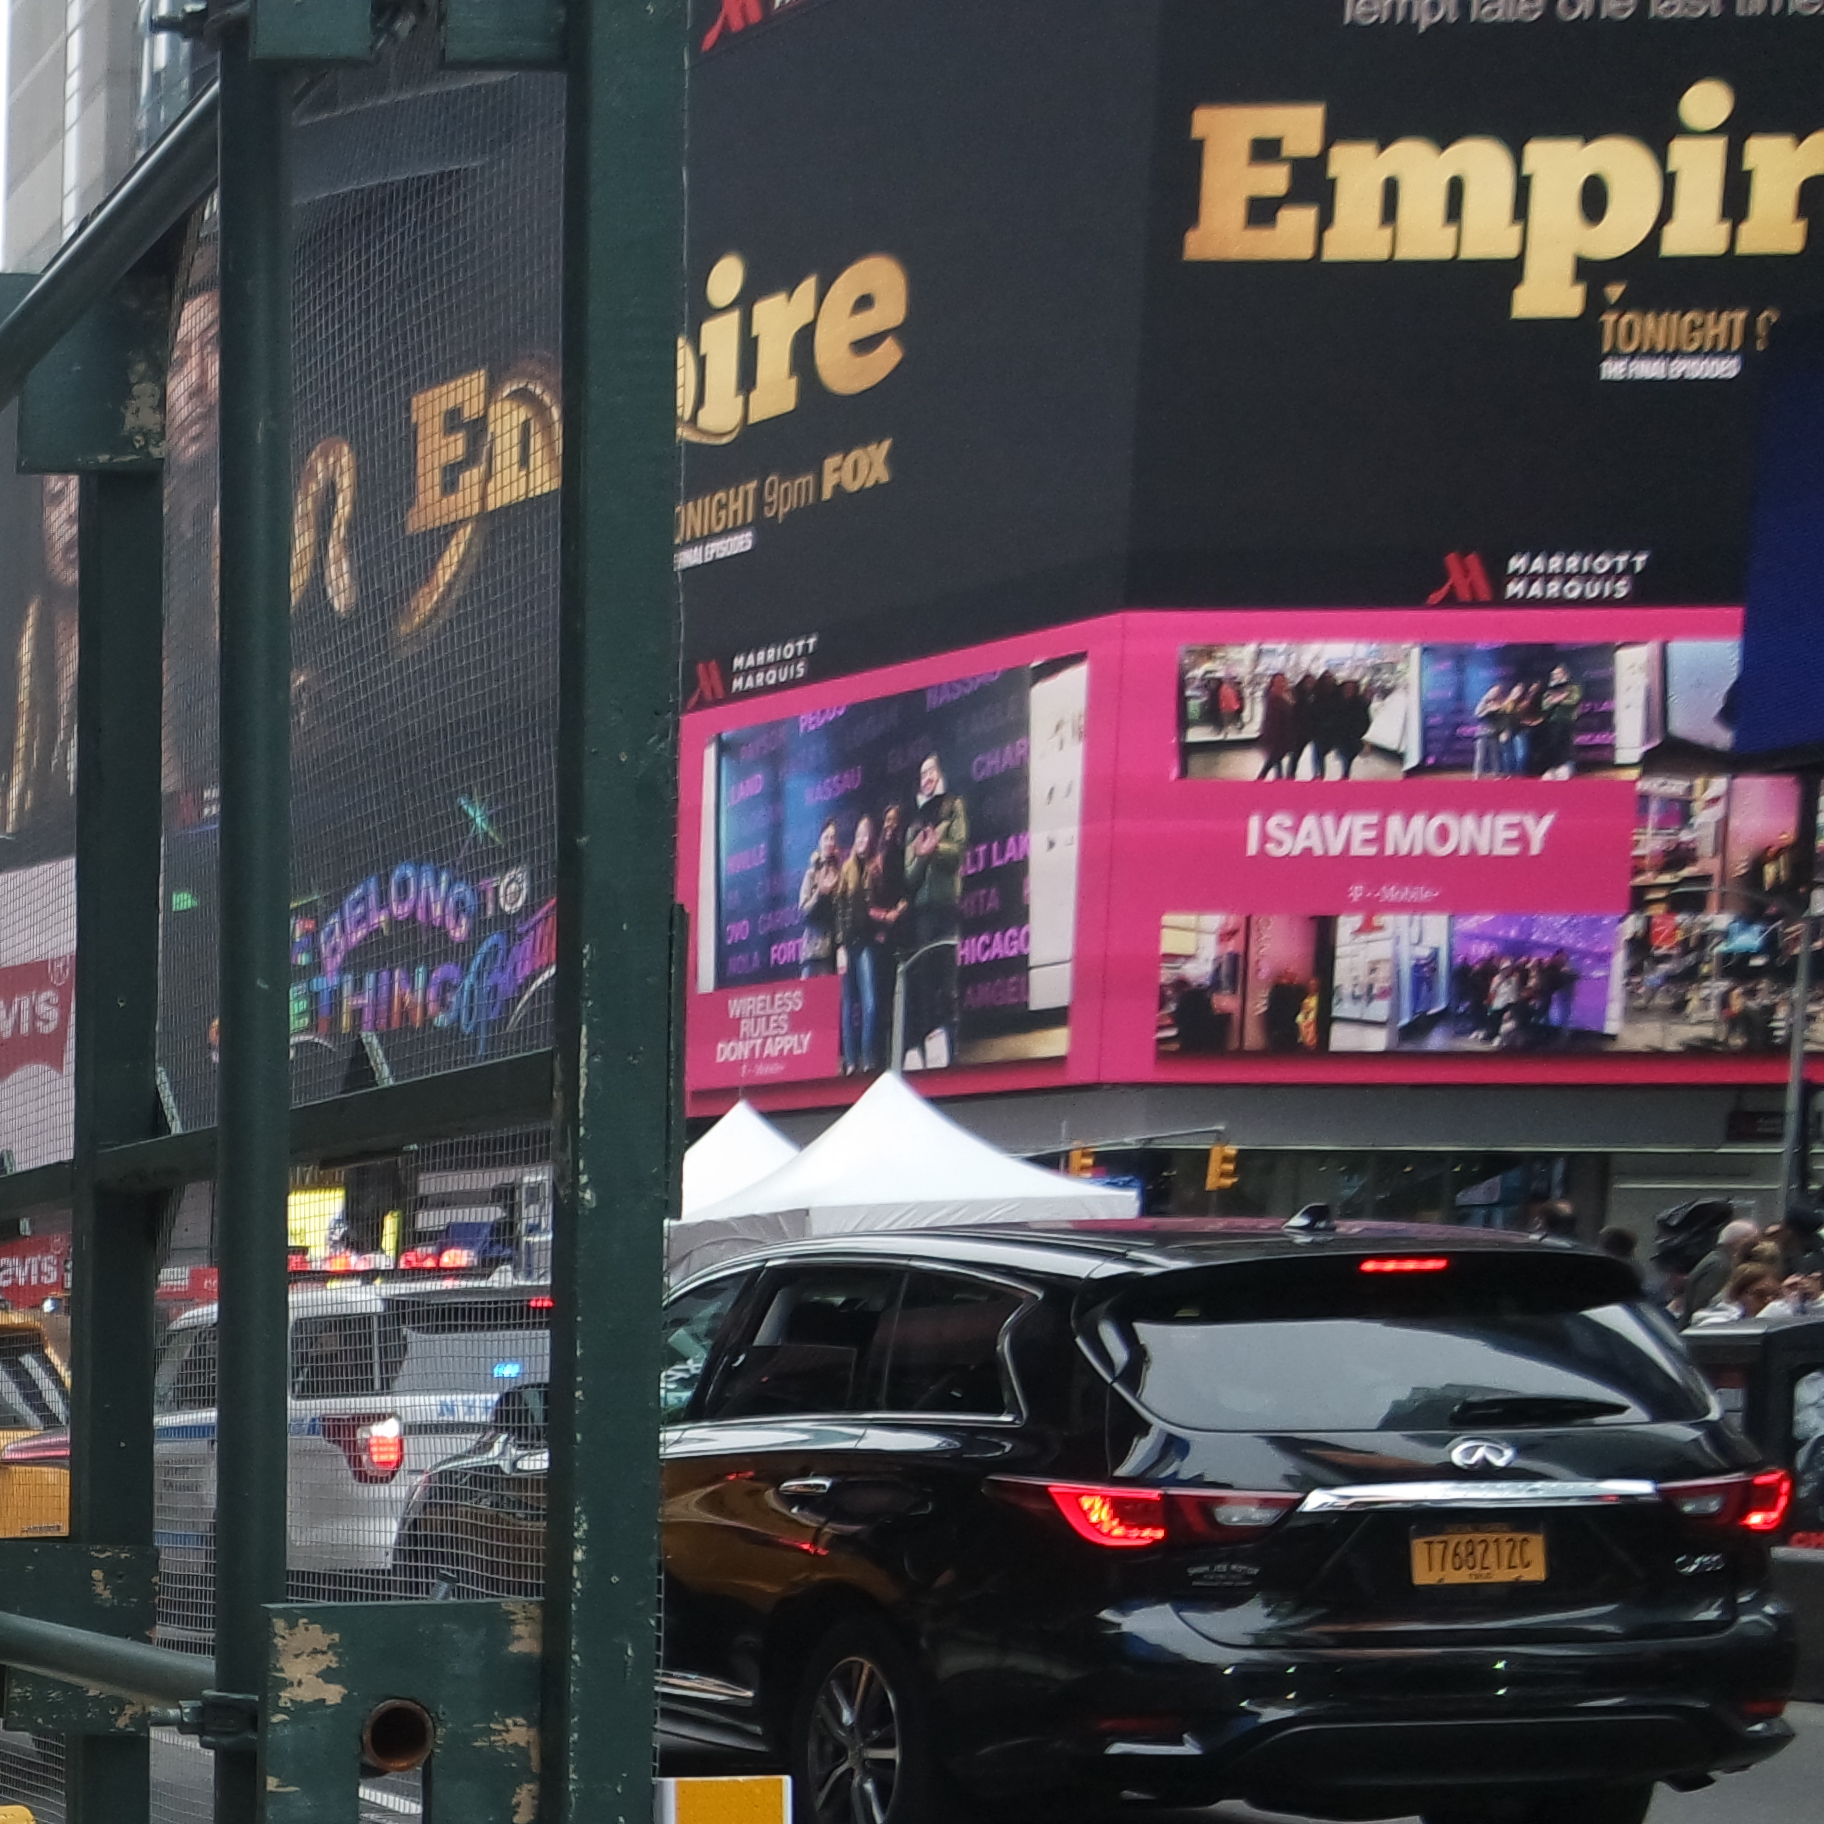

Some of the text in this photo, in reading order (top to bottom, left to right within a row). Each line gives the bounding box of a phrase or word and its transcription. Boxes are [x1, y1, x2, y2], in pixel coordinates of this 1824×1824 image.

[1599, 309, 1748, 353] TONIGHT
[763, 473, 815, 523] 9pm
[821, 437, 893, 502] FOX
[1506, 549, 1650, 576] MARRIOTT
[1503, 575, 1632, 601] MARQUIS
[732, 632, 820, 673] MARRIOTT
[731, 658, 809, 694] MARQUIS
[1246, 809, 1557, 858] I SAVE MONEY
[320, 861, 479, 980] BELONG
[728, 989, 804, 1019] WIRELESS
[739, 1012, 790, 1040] RULES
[762, 1031, 812, 1059] APPLY
